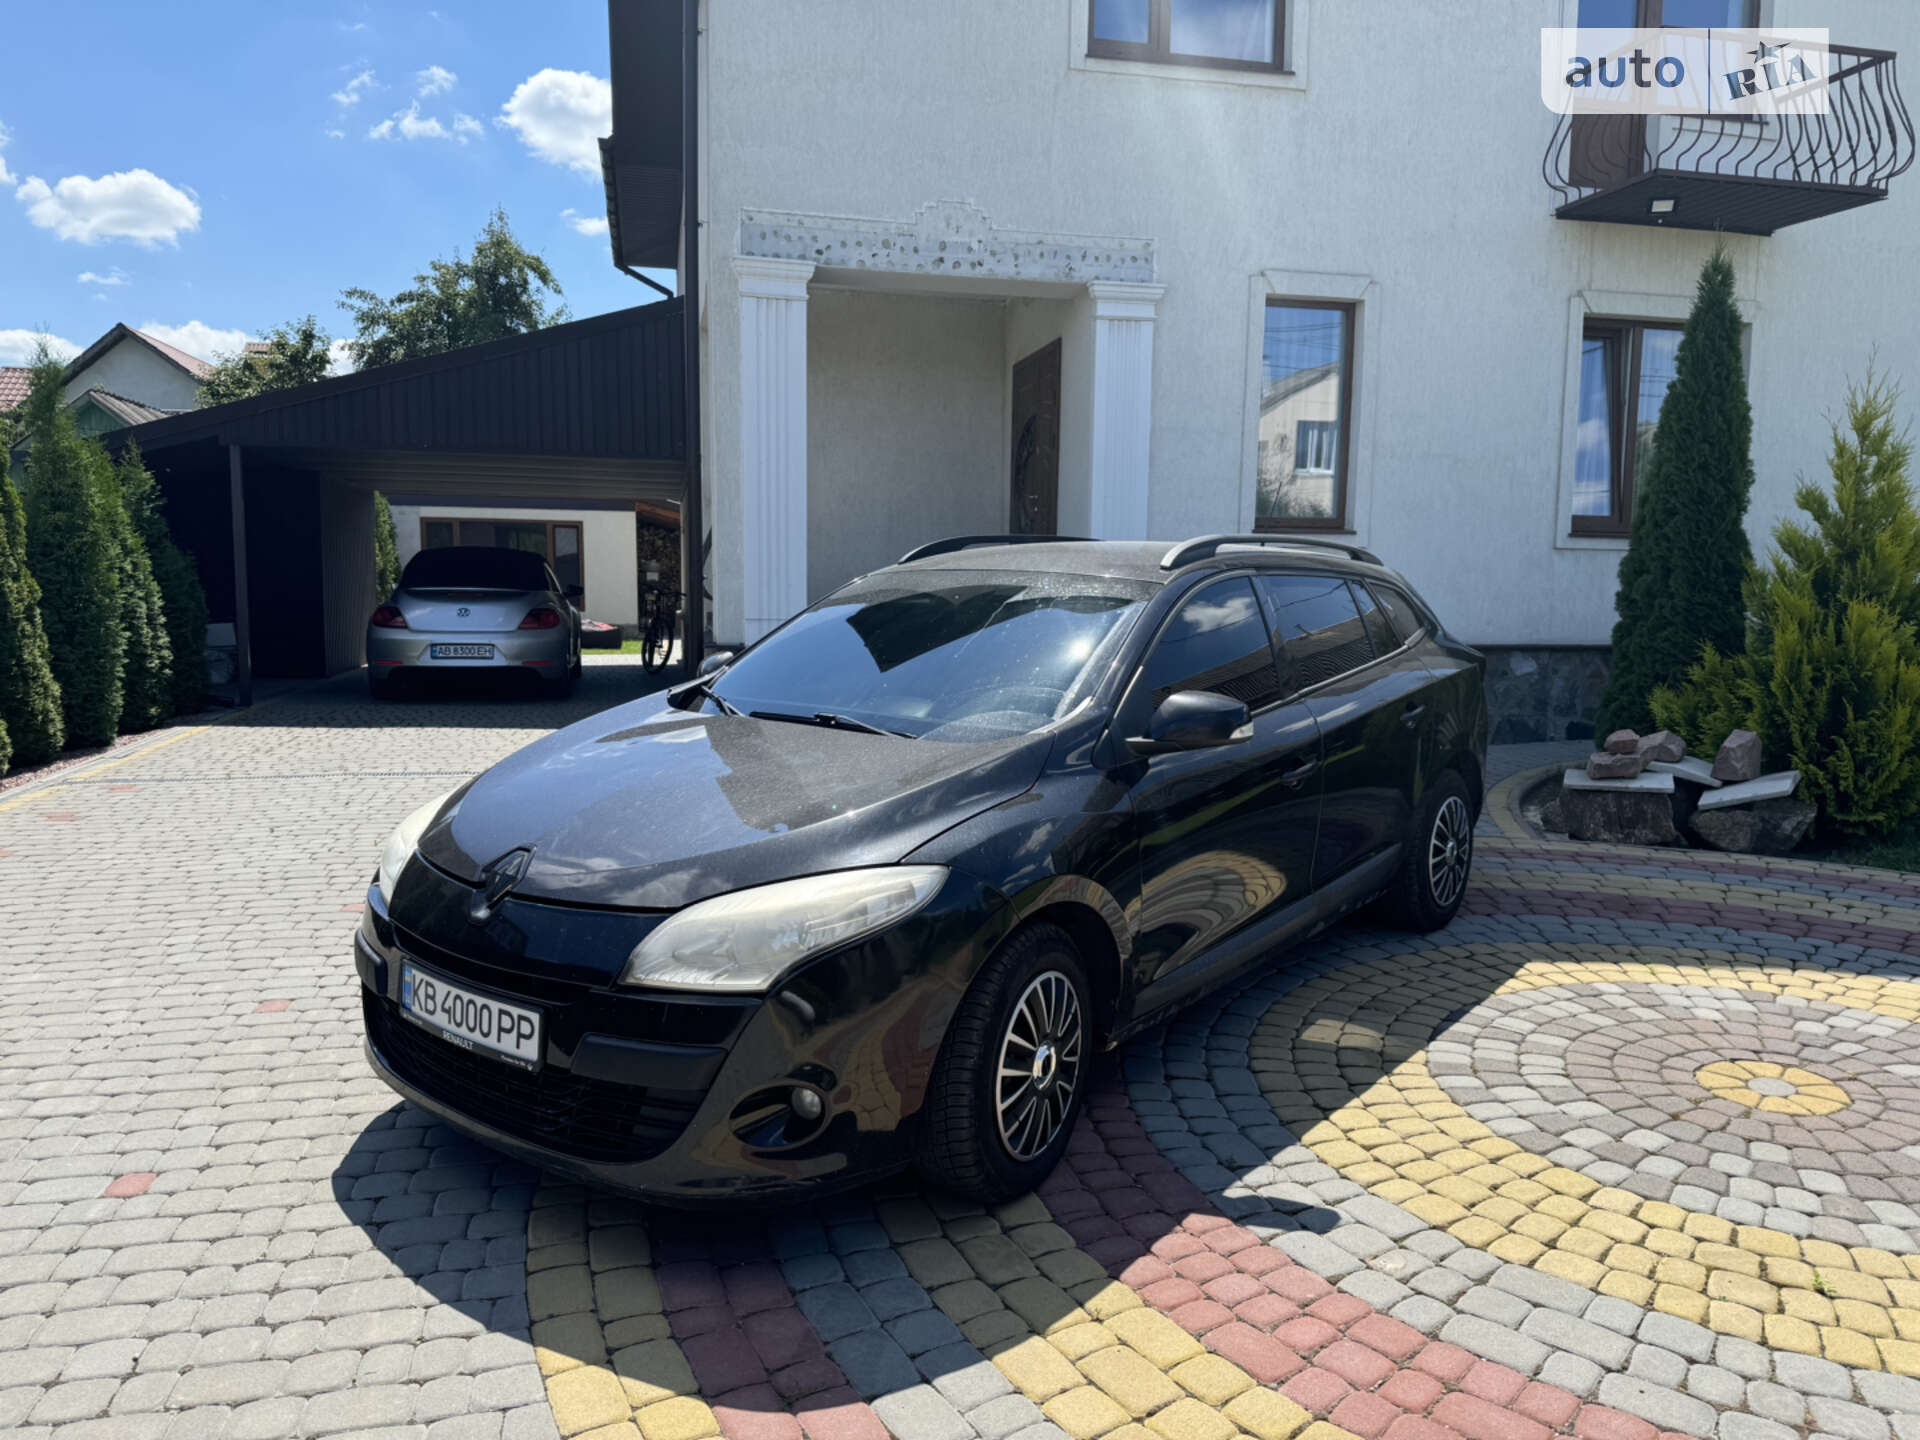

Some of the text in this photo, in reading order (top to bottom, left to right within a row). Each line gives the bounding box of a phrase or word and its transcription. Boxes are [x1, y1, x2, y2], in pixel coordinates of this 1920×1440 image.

[438, 646, 451, 656] AB
[412, 973, 535, 1050] KB 4000 PP
[442, 1029, 473, 1050] RENAULT
